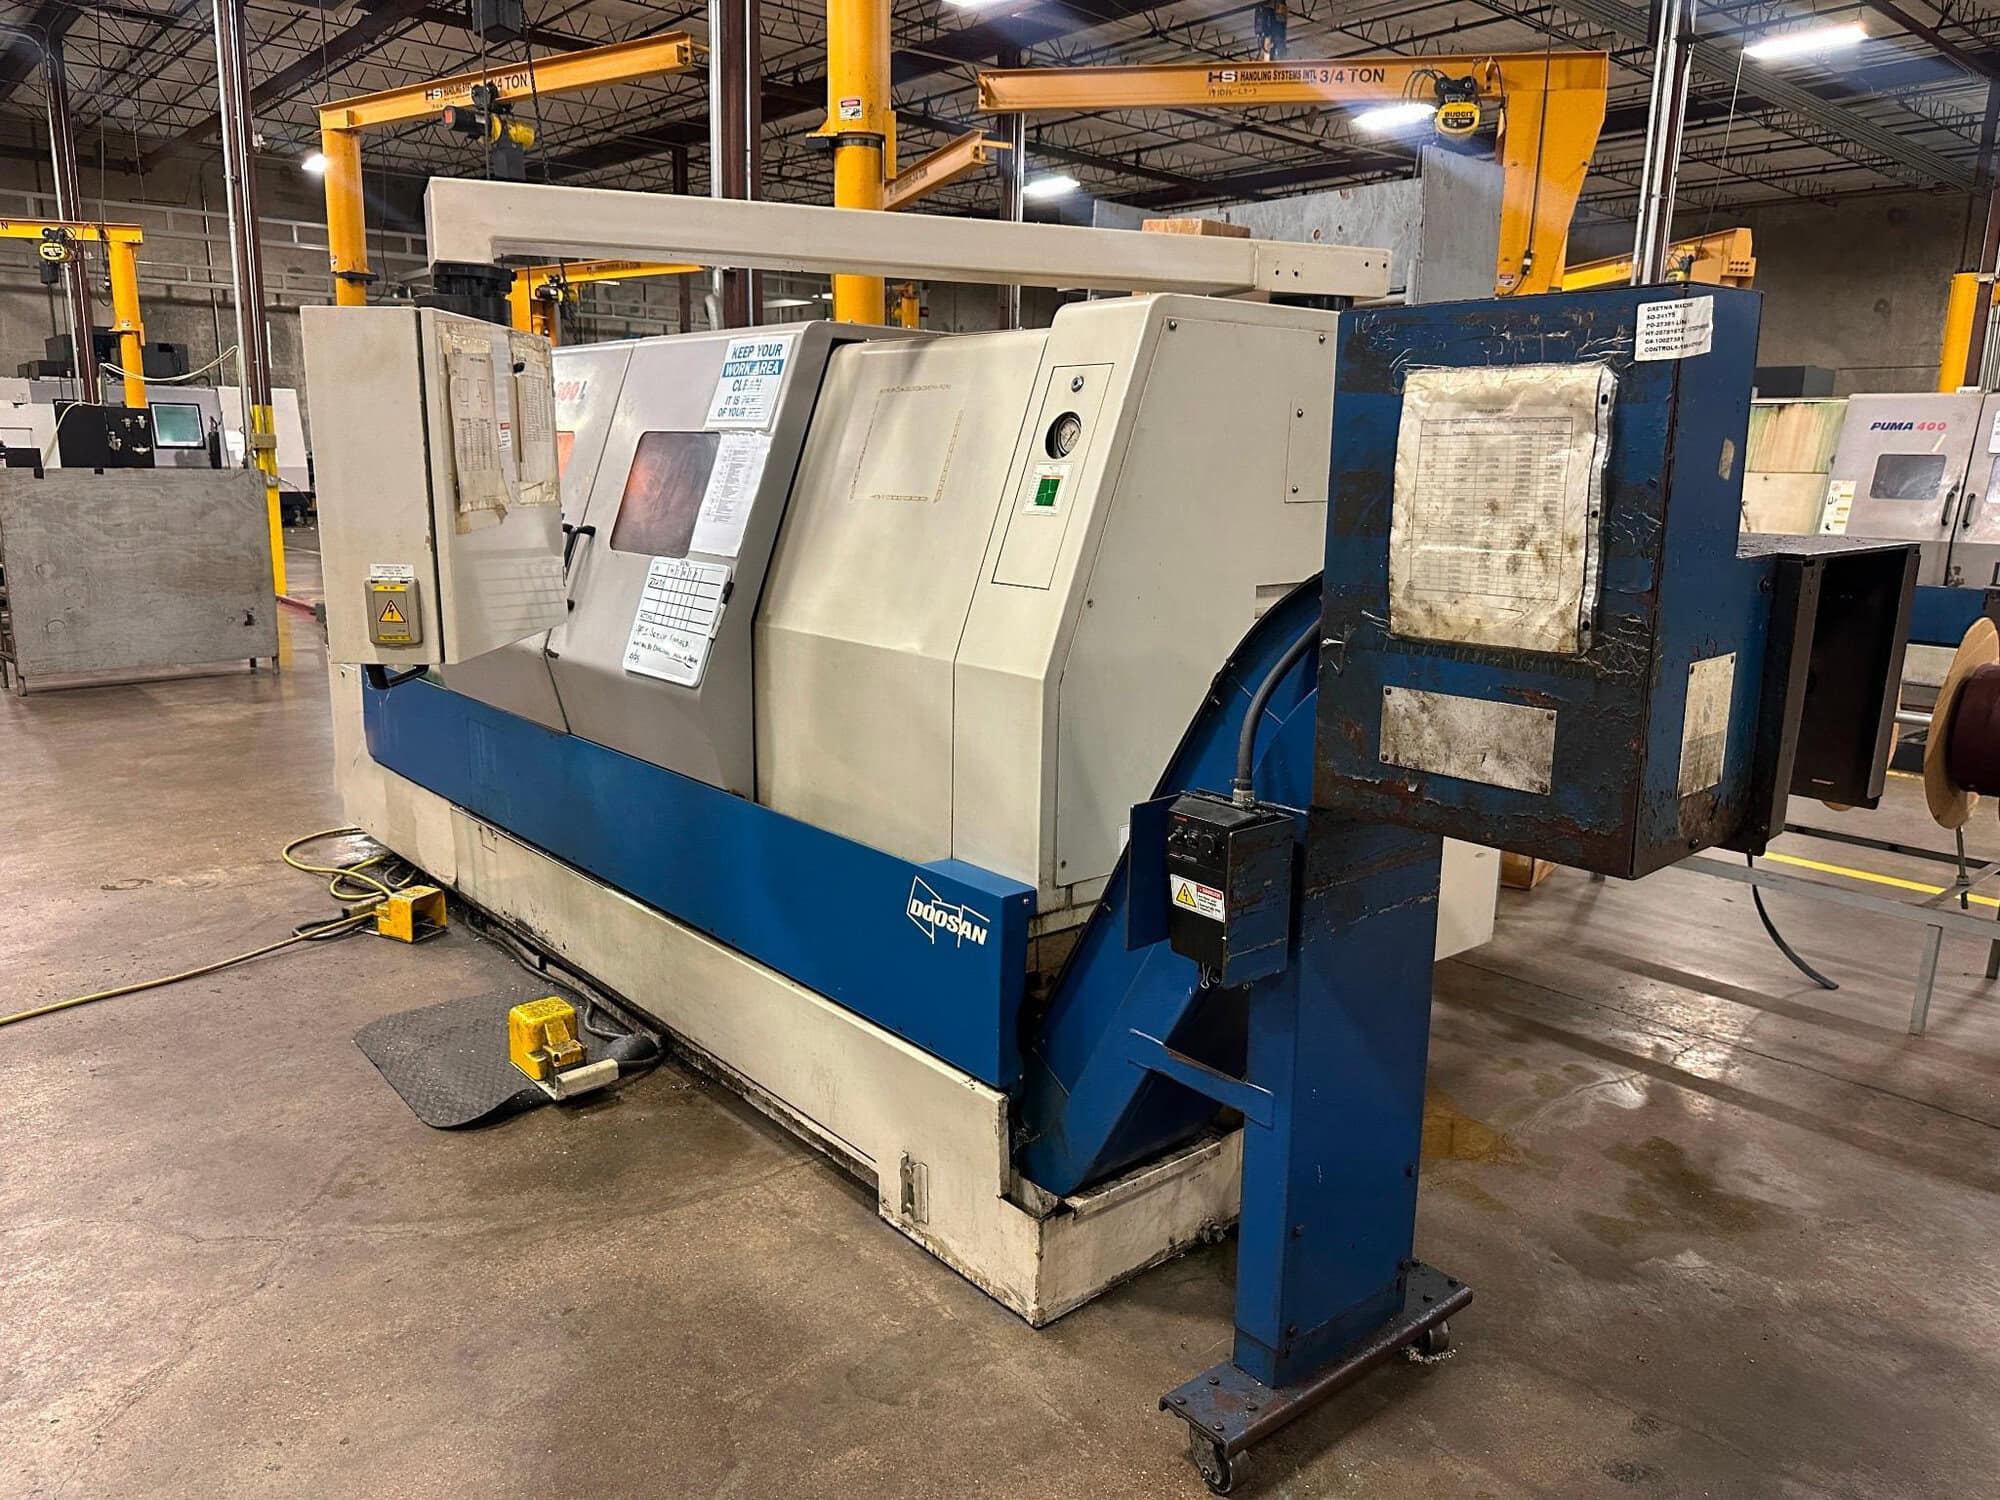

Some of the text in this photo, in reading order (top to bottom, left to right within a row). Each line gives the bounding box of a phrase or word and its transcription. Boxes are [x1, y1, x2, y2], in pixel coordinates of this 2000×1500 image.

[504, 72, 528, 91] TON
[1240, 70, 1272, 81] HANDLING
[1273, 69, 1301, 81] SYSTEMS
[1319, 69, 1345, 84] 3/4
[1347, 68, 1385, 83] TON
[732, 343, 783, 359] KEEP YOUR
[725, 361, 750, 377] WORK
[725, 396, 733, 406] IT
[733, 395, 741, 406] IS
[717, 407, 728, 417] OF
[728, 407, 747, 417] YOUR
[1870, 422, 1947, 431] PUMA 400
[909, 898, 988, 946] DOOSAN
